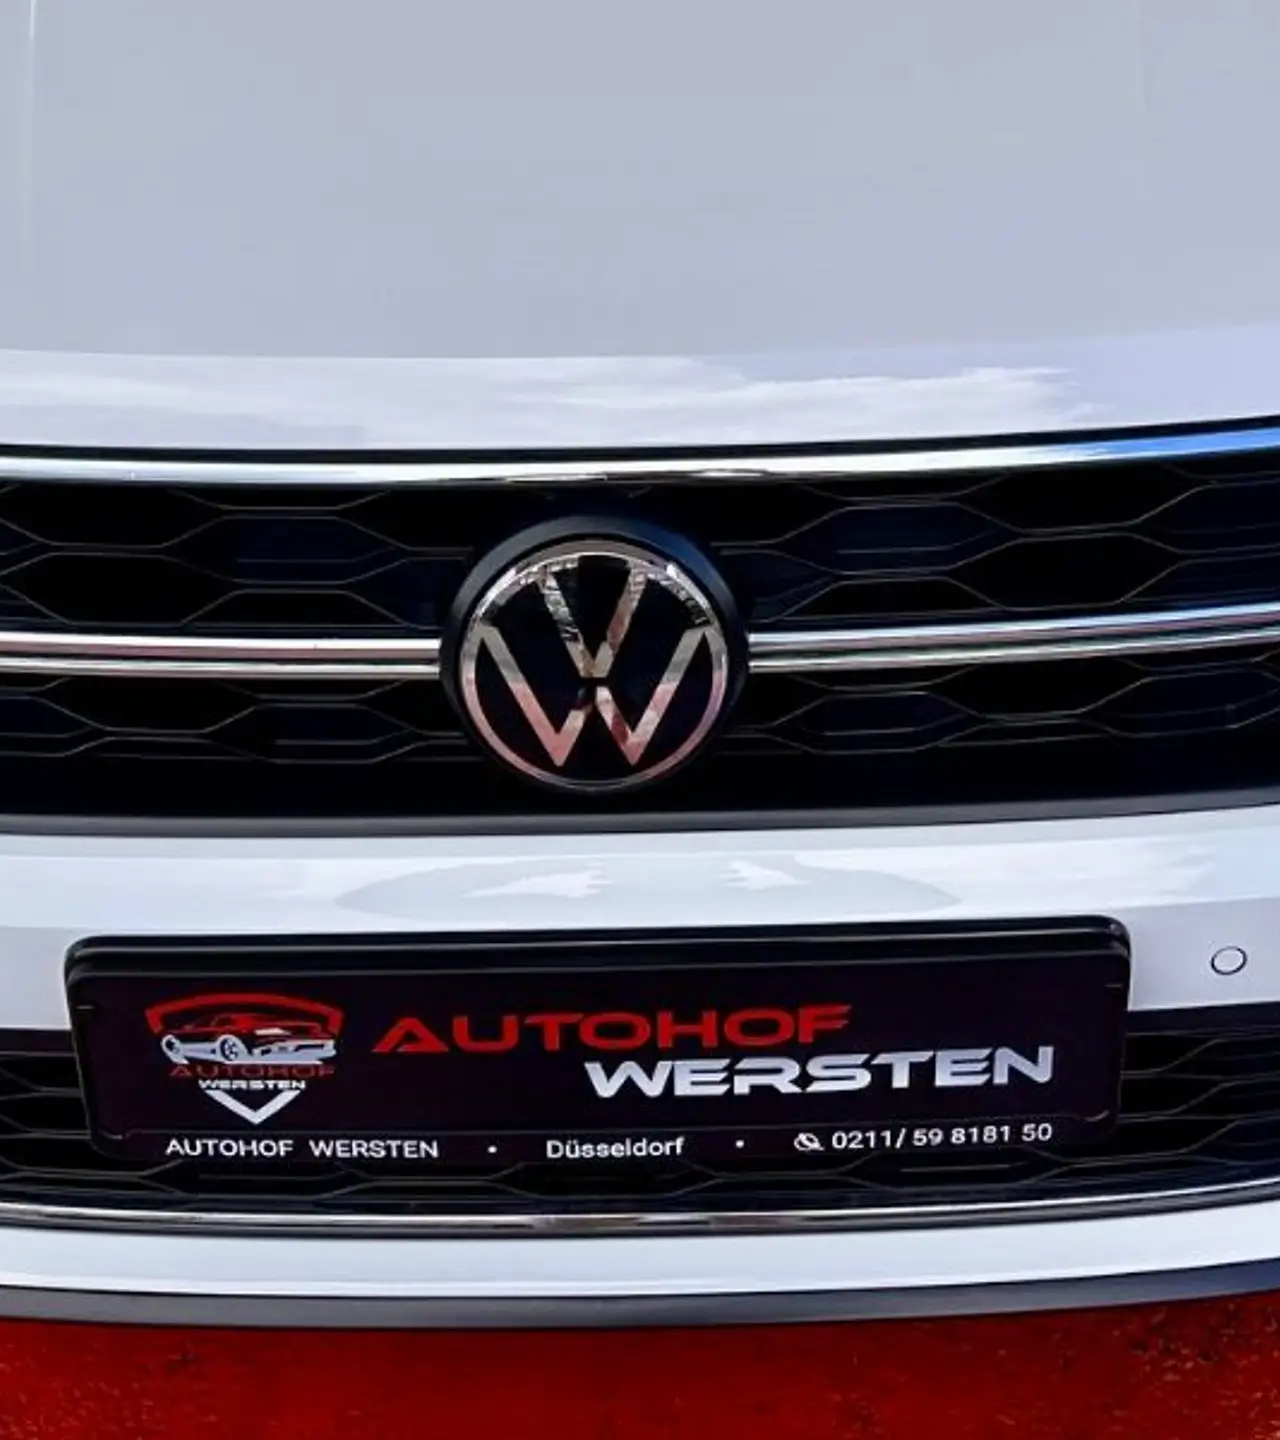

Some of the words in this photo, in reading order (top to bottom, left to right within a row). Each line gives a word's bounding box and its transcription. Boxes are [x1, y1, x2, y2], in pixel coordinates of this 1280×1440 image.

[371, 1006, 852, 1053] AUTOHOF
[170, 1064, 335, 1077] AUTOHOF
[198, 1079, 306, 1091] WERSTEN
[584, 1045, 1054, 1098] WERSTEN
[165, 1138, 294, 1159] AUTOHOF
[308, 1138, 439, 1159] WERSTEN
[546, 1136, 685, 1160] Düsseldorf
[1021, 1122, 1053, 1142] 50
